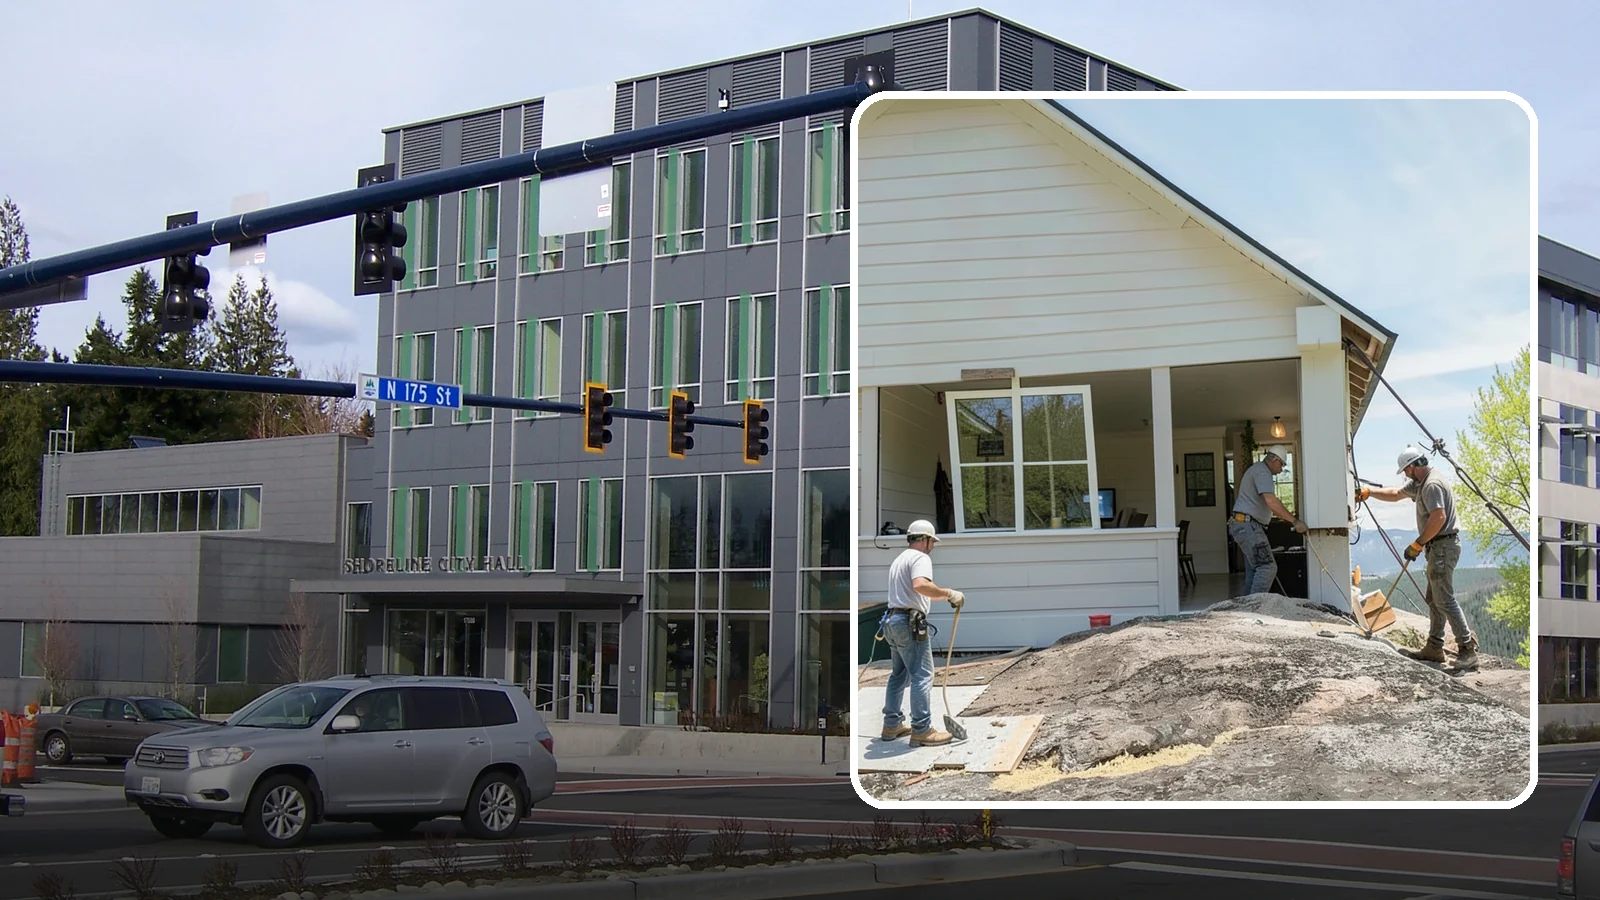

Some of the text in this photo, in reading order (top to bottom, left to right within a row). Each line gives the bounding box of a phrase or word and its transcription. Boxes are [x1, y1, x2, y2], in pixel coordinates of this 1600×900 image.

[387, 380, 452, 406] N 175 St
[344, 555, 525, 574] SHORELINE CITY HALL
